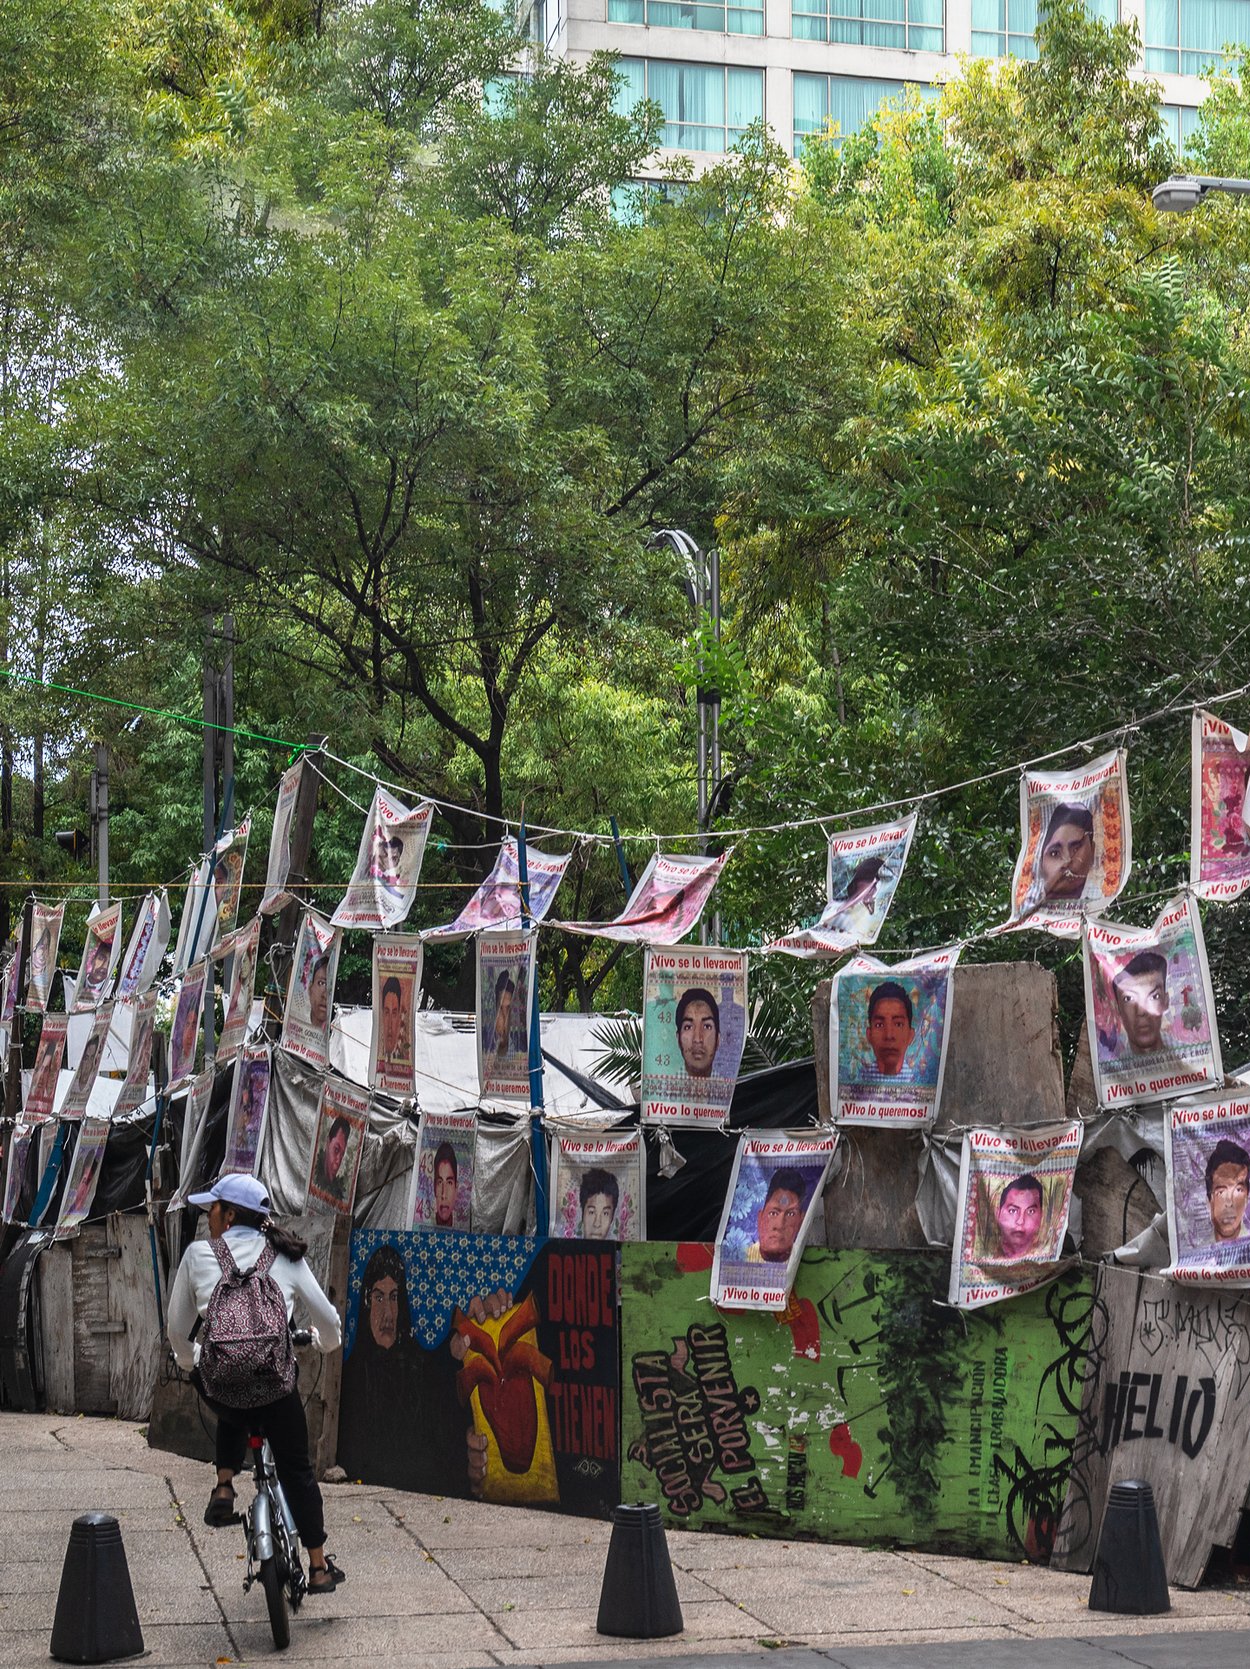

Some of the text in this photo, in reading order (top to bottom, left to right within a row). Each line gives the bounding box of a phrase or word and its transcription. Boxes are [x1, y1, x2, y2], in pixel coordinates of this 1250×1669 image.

[1028, 760, 1119, 797] ¡Vivo se lo llevaron!
[832, 836, 878, 857] ¡Vivo se lo
[656, 860, 699, 875] ¡Vivo se lo
[1205, 879, 1250, 897] ¡Vivo lo
[1087, 926, 1121, 946] ¡Vivo
[650, 955, 742, 970] ¡Vivo se lo llevaron!
[657, 1011, 672, 1024] 43
[654, 1054, 671, 1067] 43
[1107, 1068, 1208, 1101] ¡Vivo lo queremos!
[647, 1102, 691, 1117] ¡Vivo lo
[841, 1103, 927, 1119] ¡Vivo lo queremos!
[1172, 1111, 1200, 1129] ¡Vivo
[1202, 1110, 1214, 1122] se
[1217, 1105, 1228, 1118] lo
[583, 1141, 603, 1152] se lo
[745, 1140, 770, 1154] ¡Vivo
[771, 1142, 783, 1152] se
[785, 1141, 794, 1152] lo
[970, 1132, 1001, 1148] ¡Vivo
[1005, 1137, 1018, 1149] se
[1028, 1129, 1078, 1152] llevaron!
[1172, 1265, 1199, 1281] ¡Vivo
[1201, 1268, 1212, 1280] lo
[549, 1253, 613, 1327] DONDE
[723, 1287, 748, 1302] ¡Vivo
[750, 1288, 760, 1301] lo
[966, 1285, 1014, 1303] ¡Vivo lo
[559, 1329, 596, 1371] LOS
[552, 1381, 616, 1460] TIENEN
[670, 1388, 715, 1464] SERÁ
[690, 1326, 764, 1510] EL PORVENIR
[635, 1354, 700, 1514] SOCIALISTA
